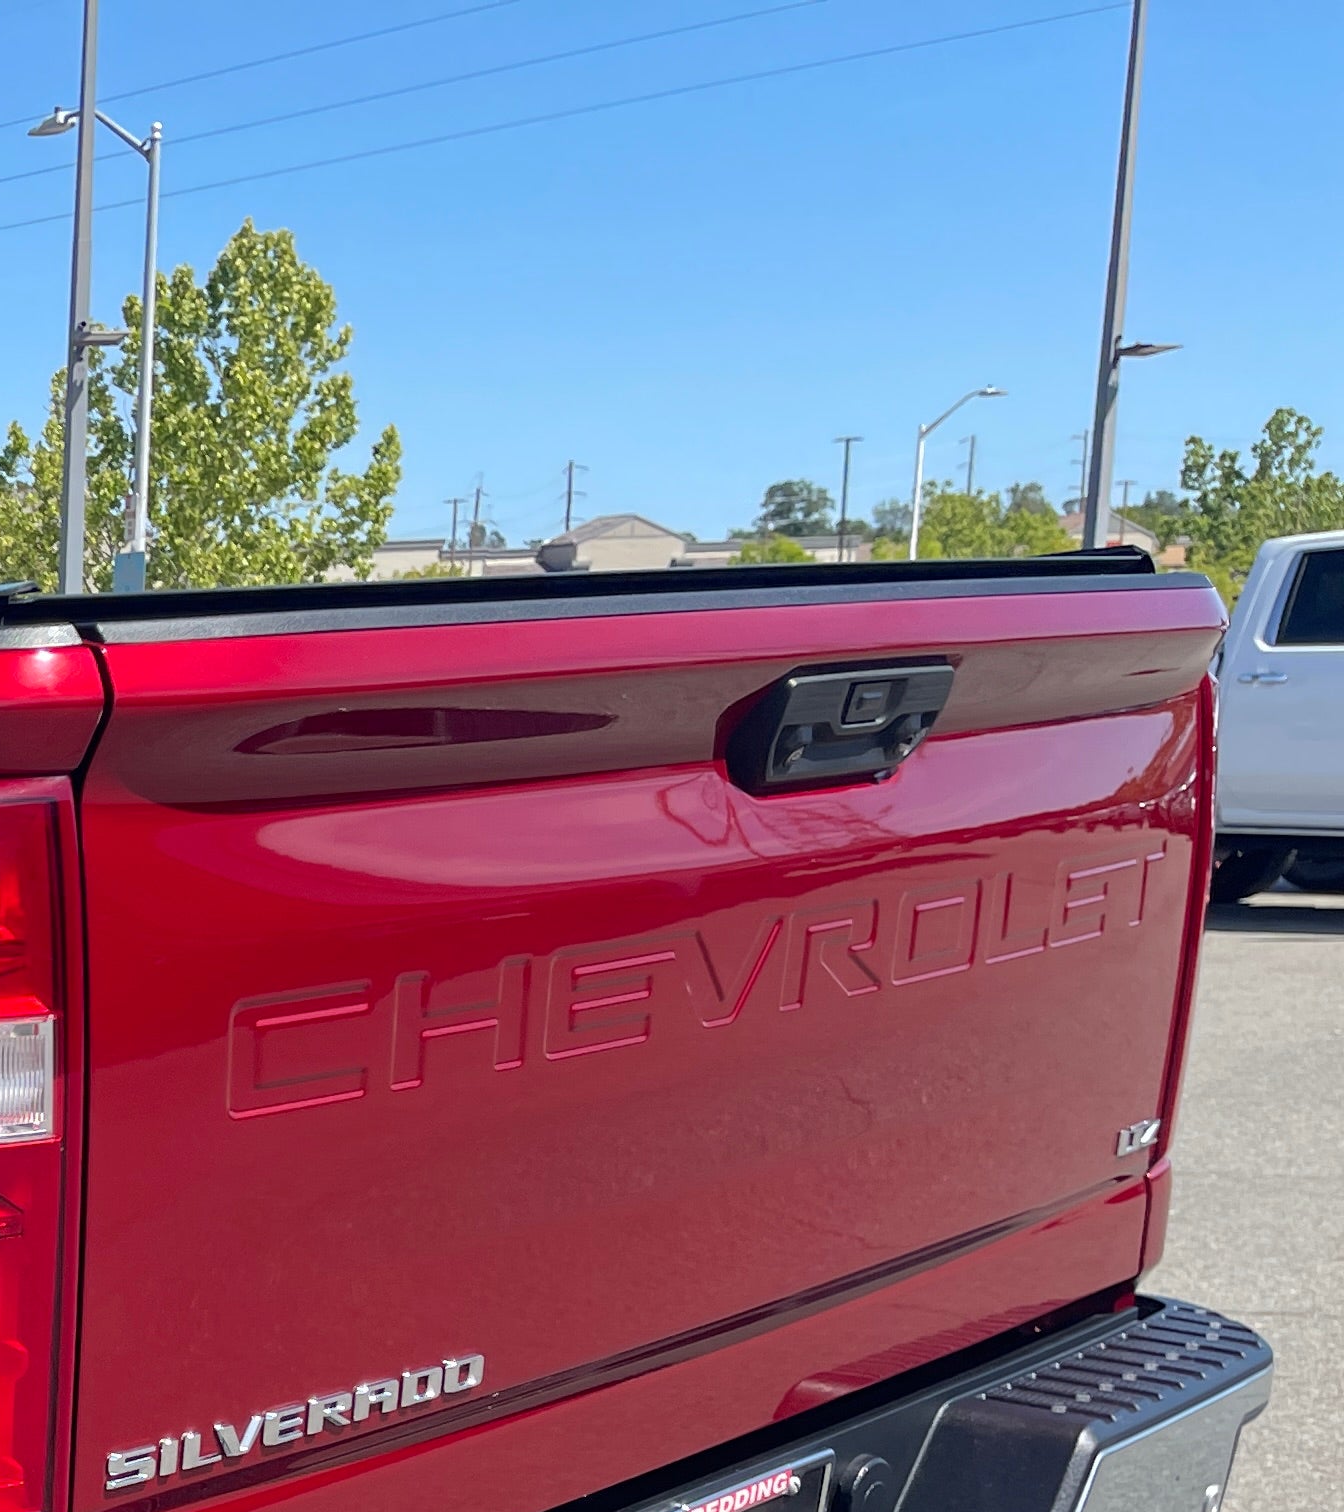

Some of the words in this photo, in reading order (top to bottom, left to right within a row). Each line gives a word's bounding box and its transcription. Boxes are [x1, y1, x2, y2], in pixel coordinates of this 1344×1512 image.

[228, 846, 1168, 1120] CHEVROLET
[1116, 1118, 1161, 1156] LTZ
[105, 1353, 485, 1491] SILVERADO
